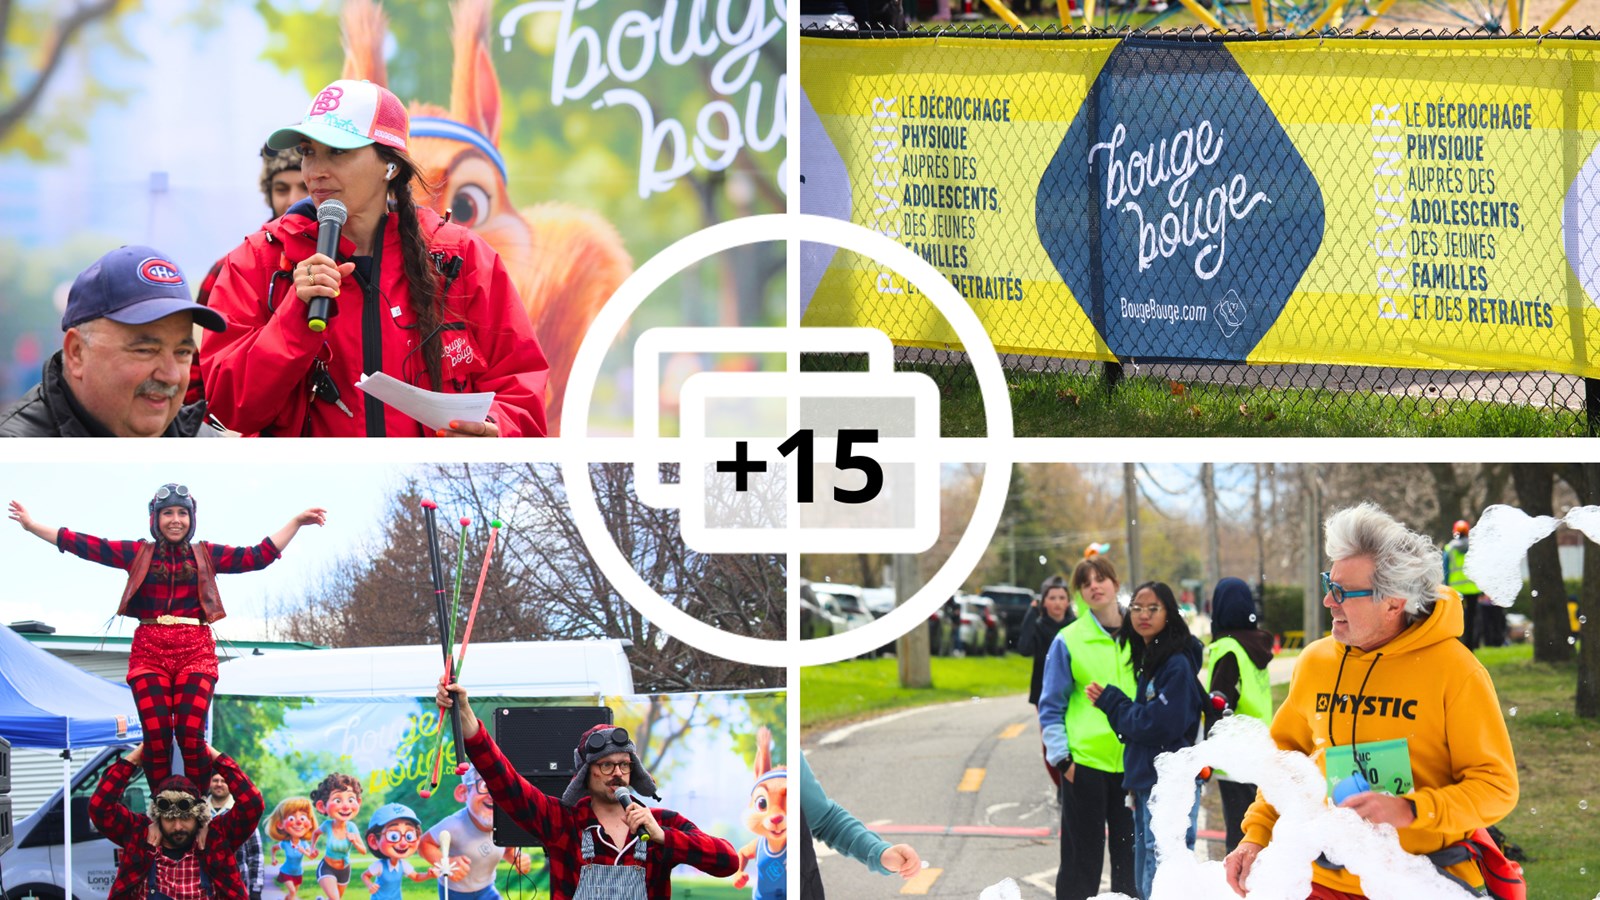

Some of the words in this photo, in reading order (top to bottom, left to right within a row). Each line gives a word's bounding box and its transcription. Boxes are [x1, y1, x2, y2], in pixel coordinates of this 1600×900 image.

[500, 0, 787, 106] boug
[901, 95, 915, 119] LE
[919, 89, 1011, 123] DÉCROCHAGE
[1405, 101, 1422, 128] LE
[1425, 96, 1532, 130] DÉCROCHAGE
[592, 74, 787, 199] bou
[901, 124, 968, 151] PHYSIQUE
[1406, 134, 1484, 162] PHYSIQUE
[901, 149, 949, 179] AUPRÈS
[953, 156, 977, 181] DES
[1088, 120, 1224, 210] bouge
[1407, 161, 1464, 193] AUPRÈS
[1469, 168, 1496, 195] DES
[903, 183, 1002, 213] ADOLESCENTS,
[1368, 103, 1409, 320] PRÉVENIR
[904, 212, 927, 237] DES
[930, 214, 976, 240] JEUNES
[1121, 174, 1272, 280] bouge
[1410, 198, 1525, 232] ADOLESCENTS,
[1411, 230, 1438, 256] DES
[1443, 232, 1496, 260] JEUNES
[1411, 262, 1489, 292] FAMILLES
[1120, 297, 1207, 325] BougeBouge.com
[1413, 294, 1429, 320] ET
[1435, 295, 1463, 322] DES
[1467, 295, 1554, 329] RETRAITÉS
[1330, 693, 1418, 721] MYSTIC
[1393, 777, 1405, 796] 2
